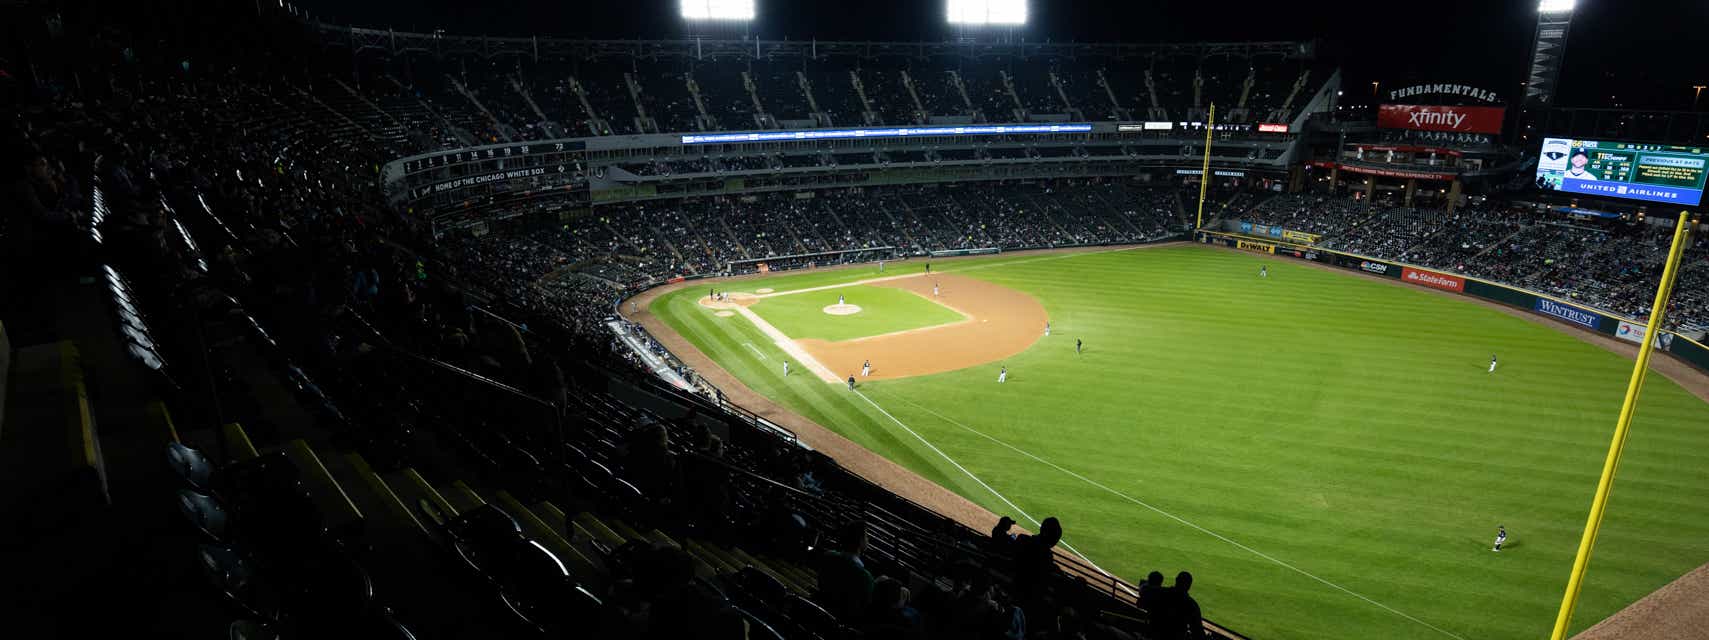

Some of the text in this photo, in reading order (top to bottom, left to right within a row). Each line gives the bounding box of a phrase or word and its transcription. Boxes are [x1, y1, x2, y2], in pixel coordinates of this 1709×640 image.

[1390, 84, 1496, 102] FUNDAMENTALS
[1408, 109, 1466, 128] xfinity
[435, 167, 545, 192] HOME OF THE CHICAGO WHITE SOX
[1580, 183, 1678, 199] UNITED AIRLINES
[1370, 262, 1387, 271] CSN
